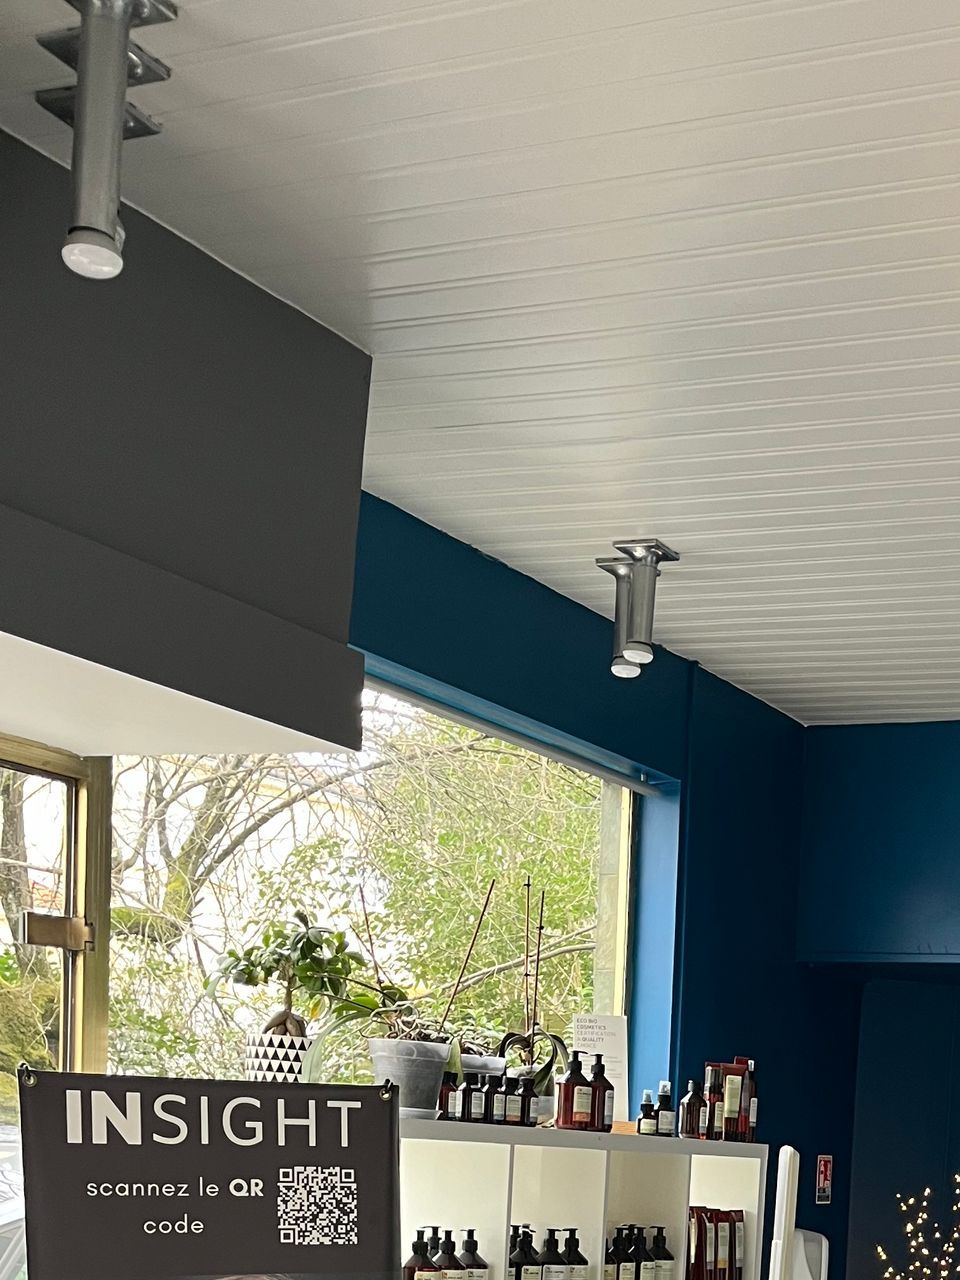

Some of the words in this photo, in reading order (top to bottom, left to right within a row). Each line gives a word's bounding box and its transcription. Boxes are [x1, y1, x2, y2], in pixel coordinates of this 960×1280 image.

[65, 1089, 363, 1148] INSIGHT
[86, 1179, 190, 1198] scannez
[199, 1176, 220, 1198] le
[228, 1178, 265, 1198] QR
[143, 1213, 205, 1235] code
